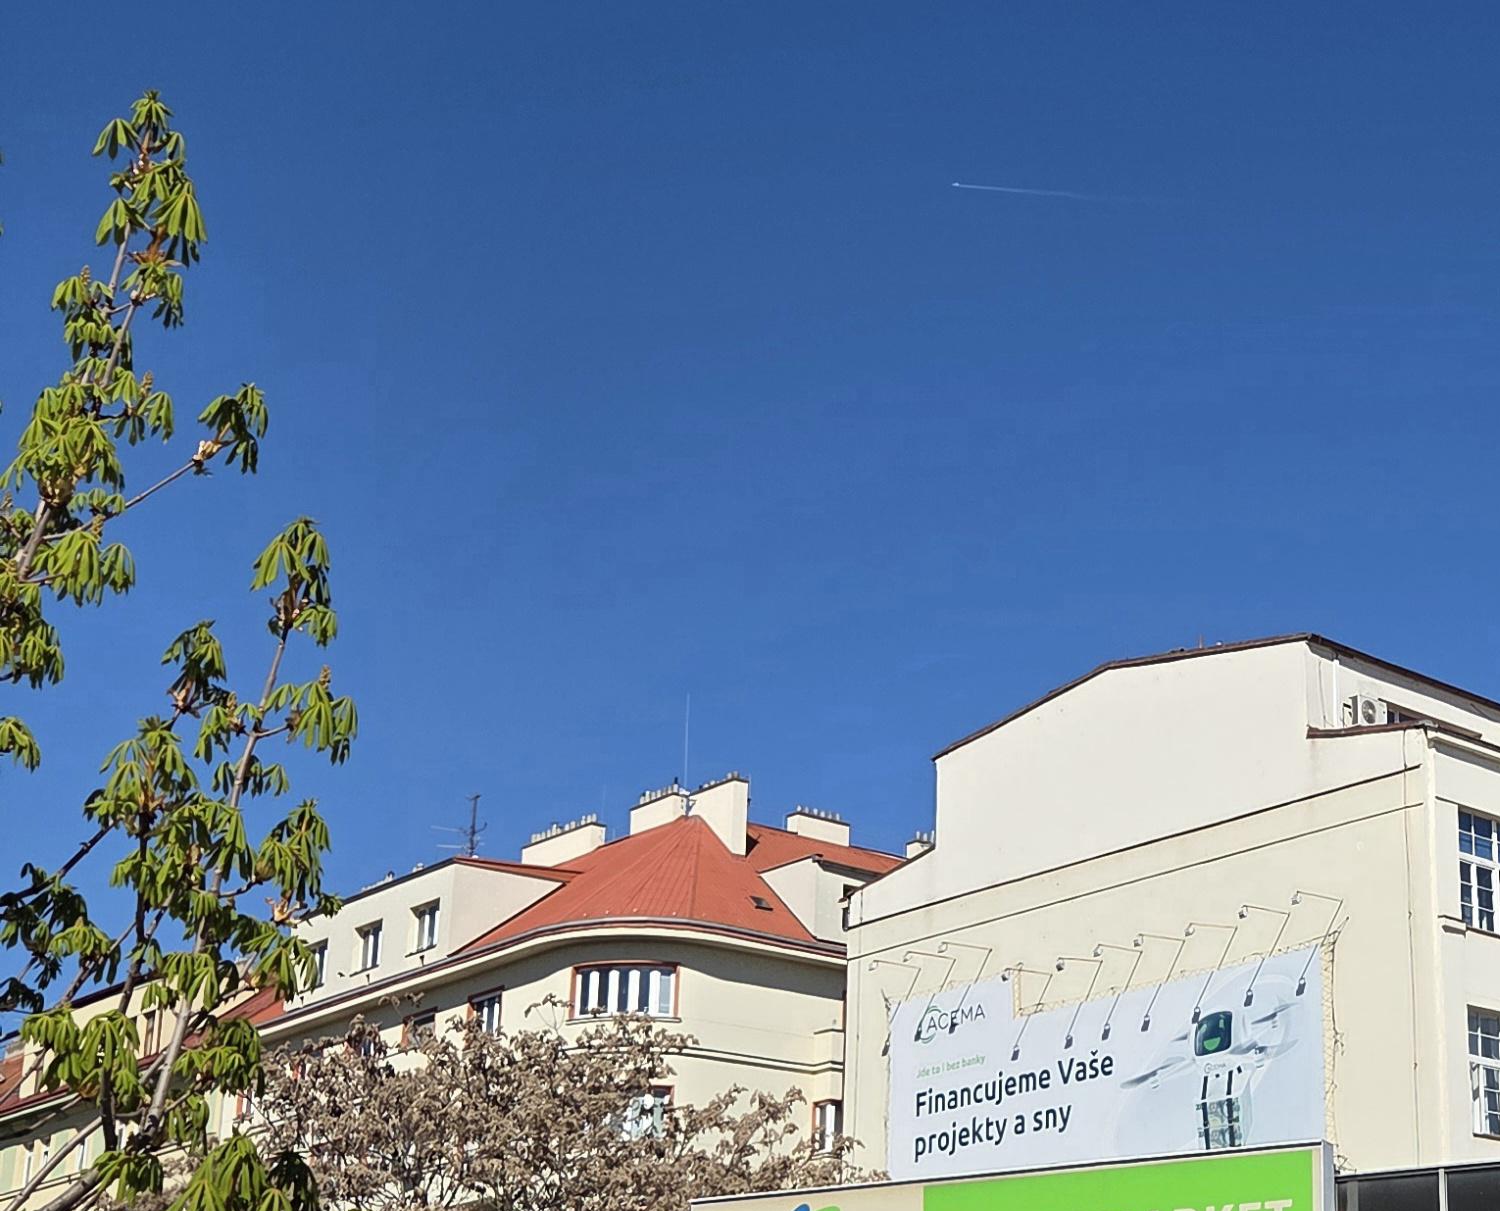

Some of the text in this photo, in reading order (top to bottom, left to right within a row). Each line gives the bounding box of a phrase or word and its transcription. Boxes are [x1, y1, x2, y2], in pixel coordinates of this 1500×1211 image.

[926, 1003, 986, 1033] ACEMA
[915, 1050, 1114, 1117] Financujeme Vaše
[914, 1104, 1072, 1163] projekty a sny
